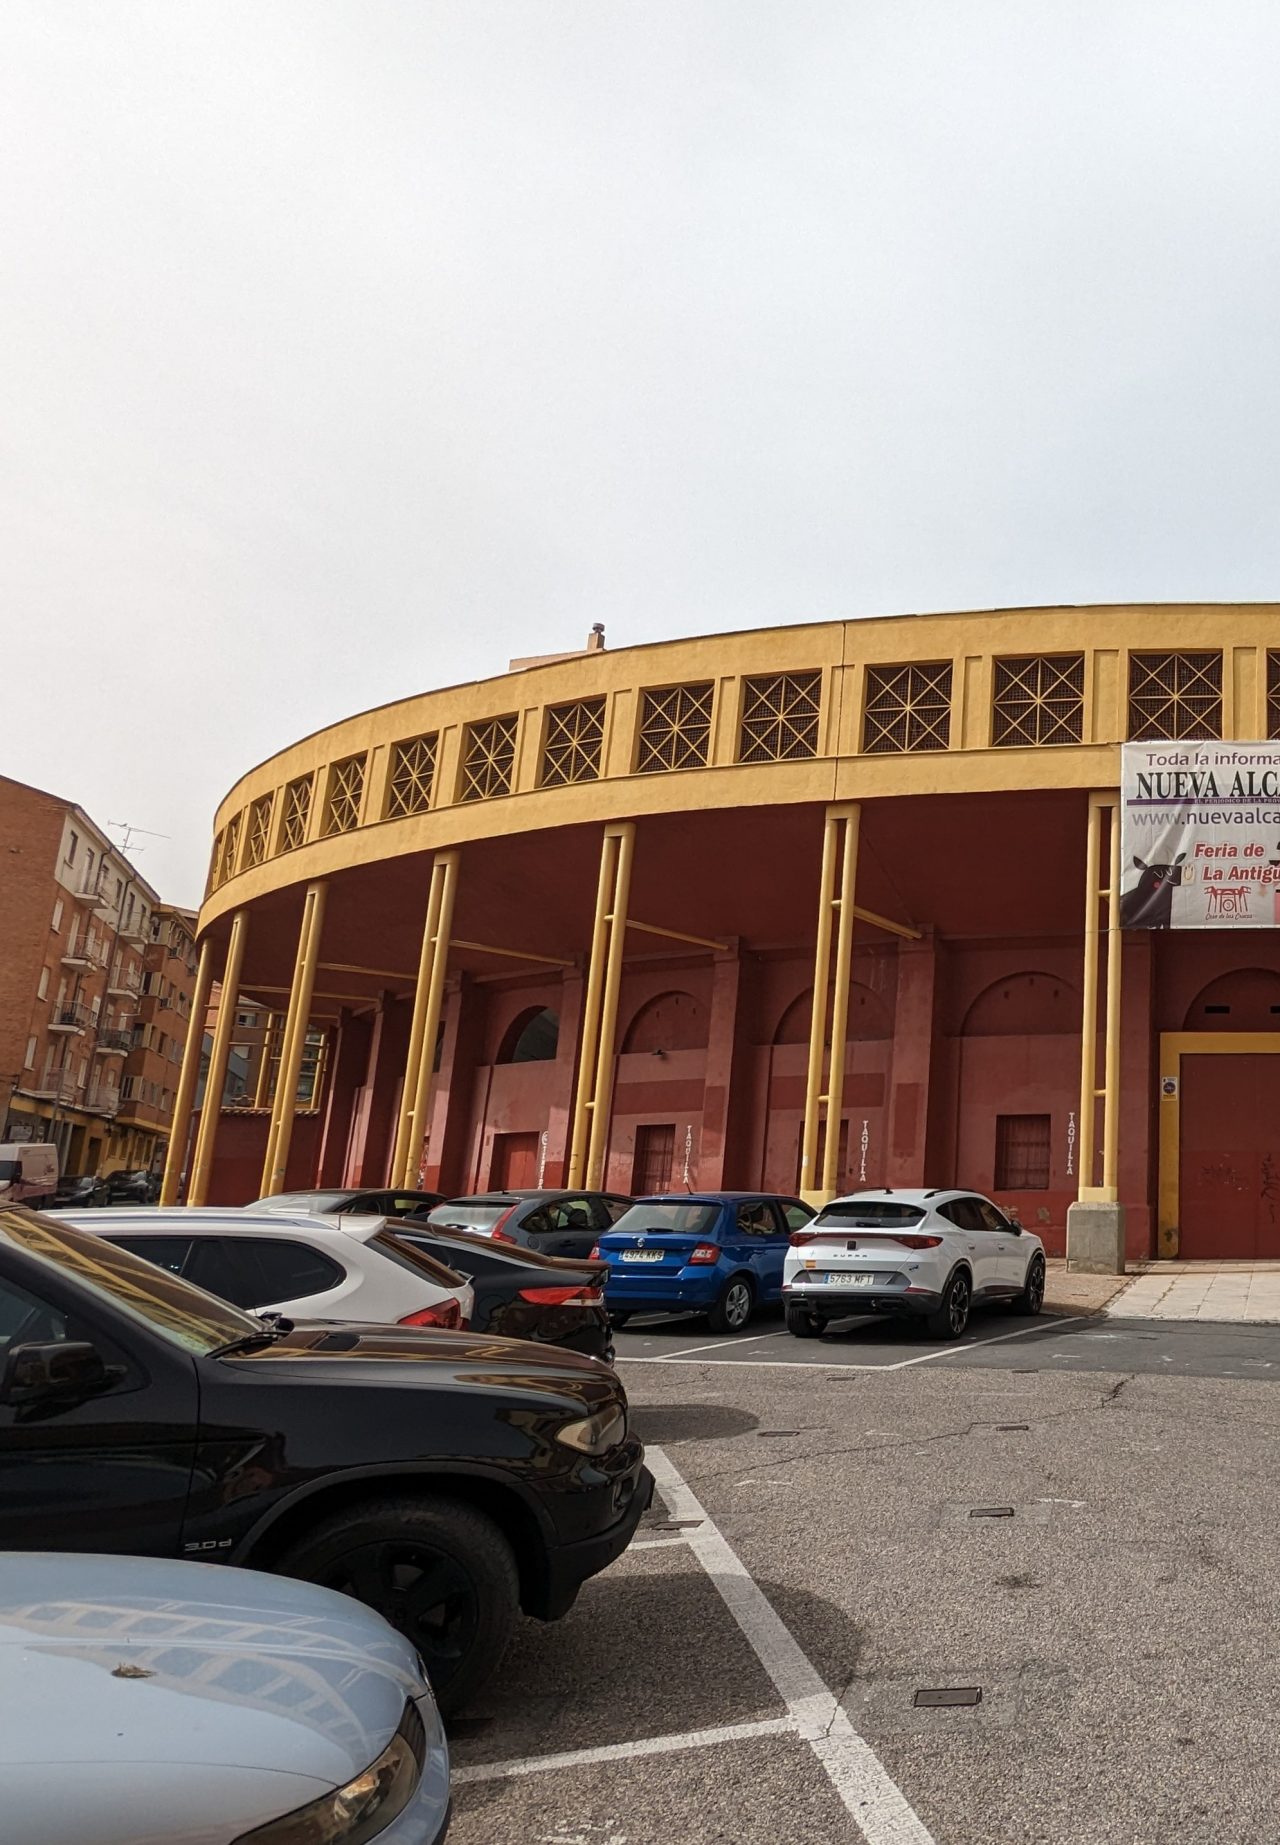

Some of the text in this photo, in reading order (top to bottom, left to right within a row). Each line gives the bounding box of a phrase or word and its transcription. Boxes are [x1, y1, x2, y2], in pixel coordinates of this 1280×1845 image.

[1146, 753, 1189, 766] Toda
[1195, 753, 1209, 766] la
[1136, 771, 1220, 799] NUEVA
[1195, 843, 1265, 858] Feria de
[1203, 866, 1224, 881] La
[683, 1125, 692, 1184] TAQUILLA
[860, 1120, 869, 1181] TAQUILLA
[1066, 1112, 1076, 1175] TAQUILLA
